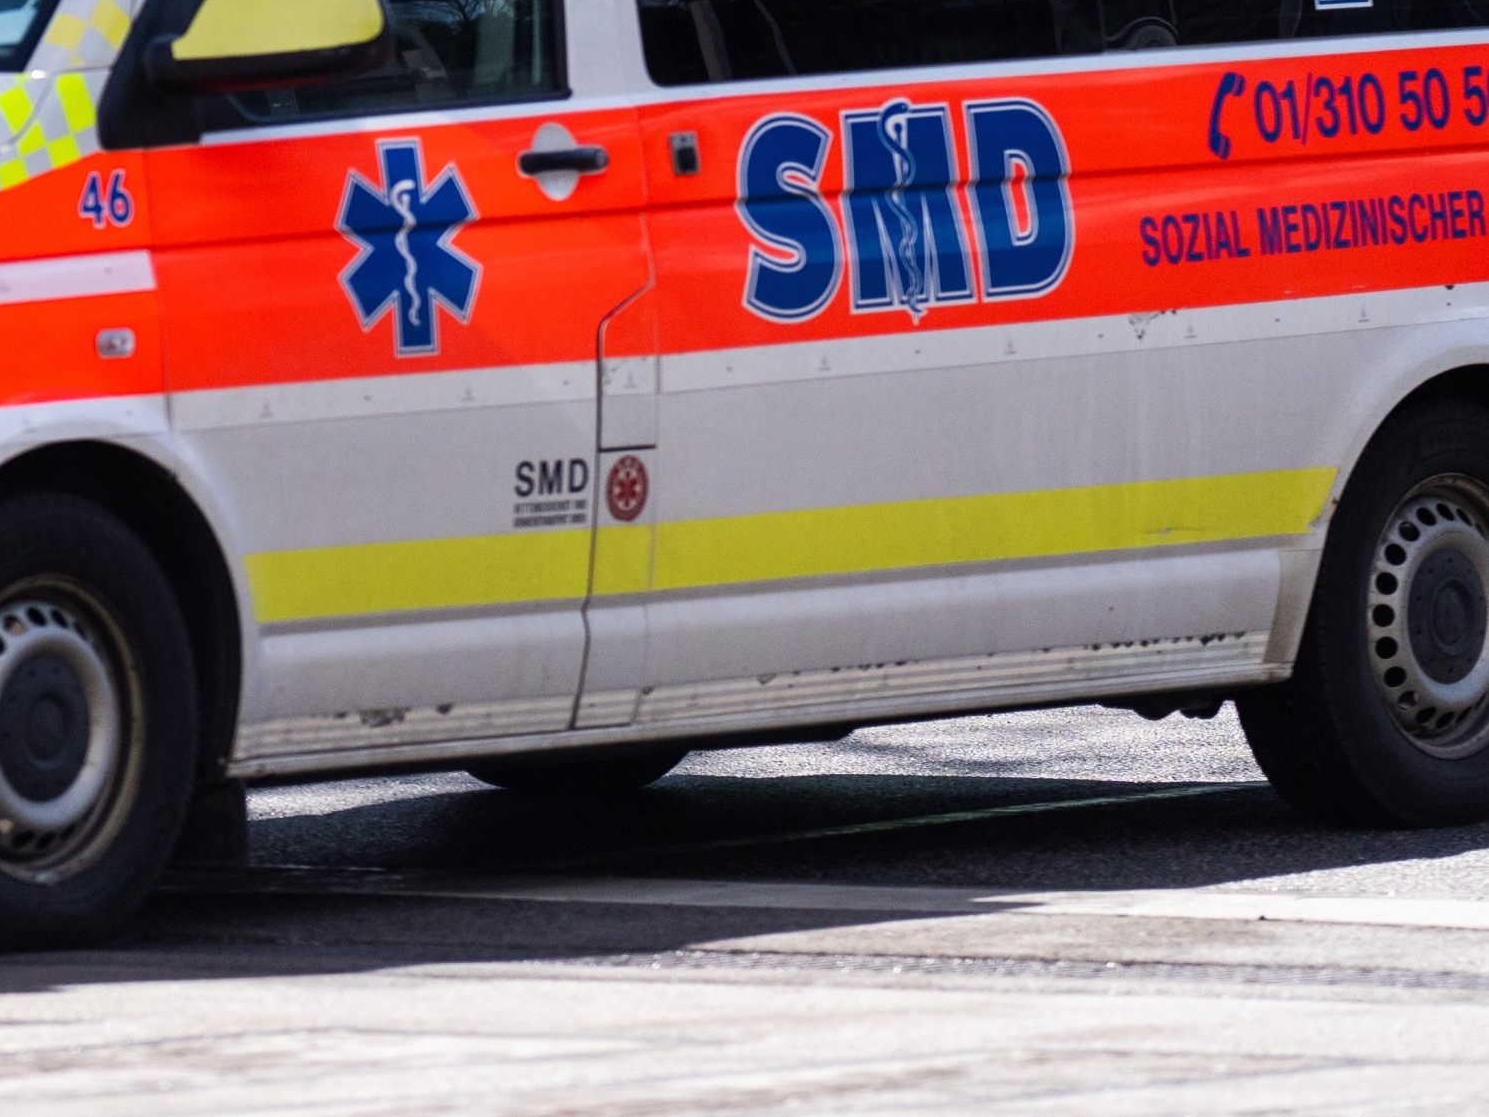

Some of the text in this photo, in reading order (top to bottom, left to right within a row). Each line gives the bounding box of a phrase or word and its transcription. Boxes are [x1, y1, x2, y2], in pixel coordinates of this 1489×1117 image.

[1253, 64, 1489, 146] 01/310 50 5
[79, 169, 134, 228] 46
[735, 100, 1073, 325] SMD
[1139, 189, 1487, 267] SOZIAL MEDIZINISCHER
[514, 457, 589, 498] SMD
